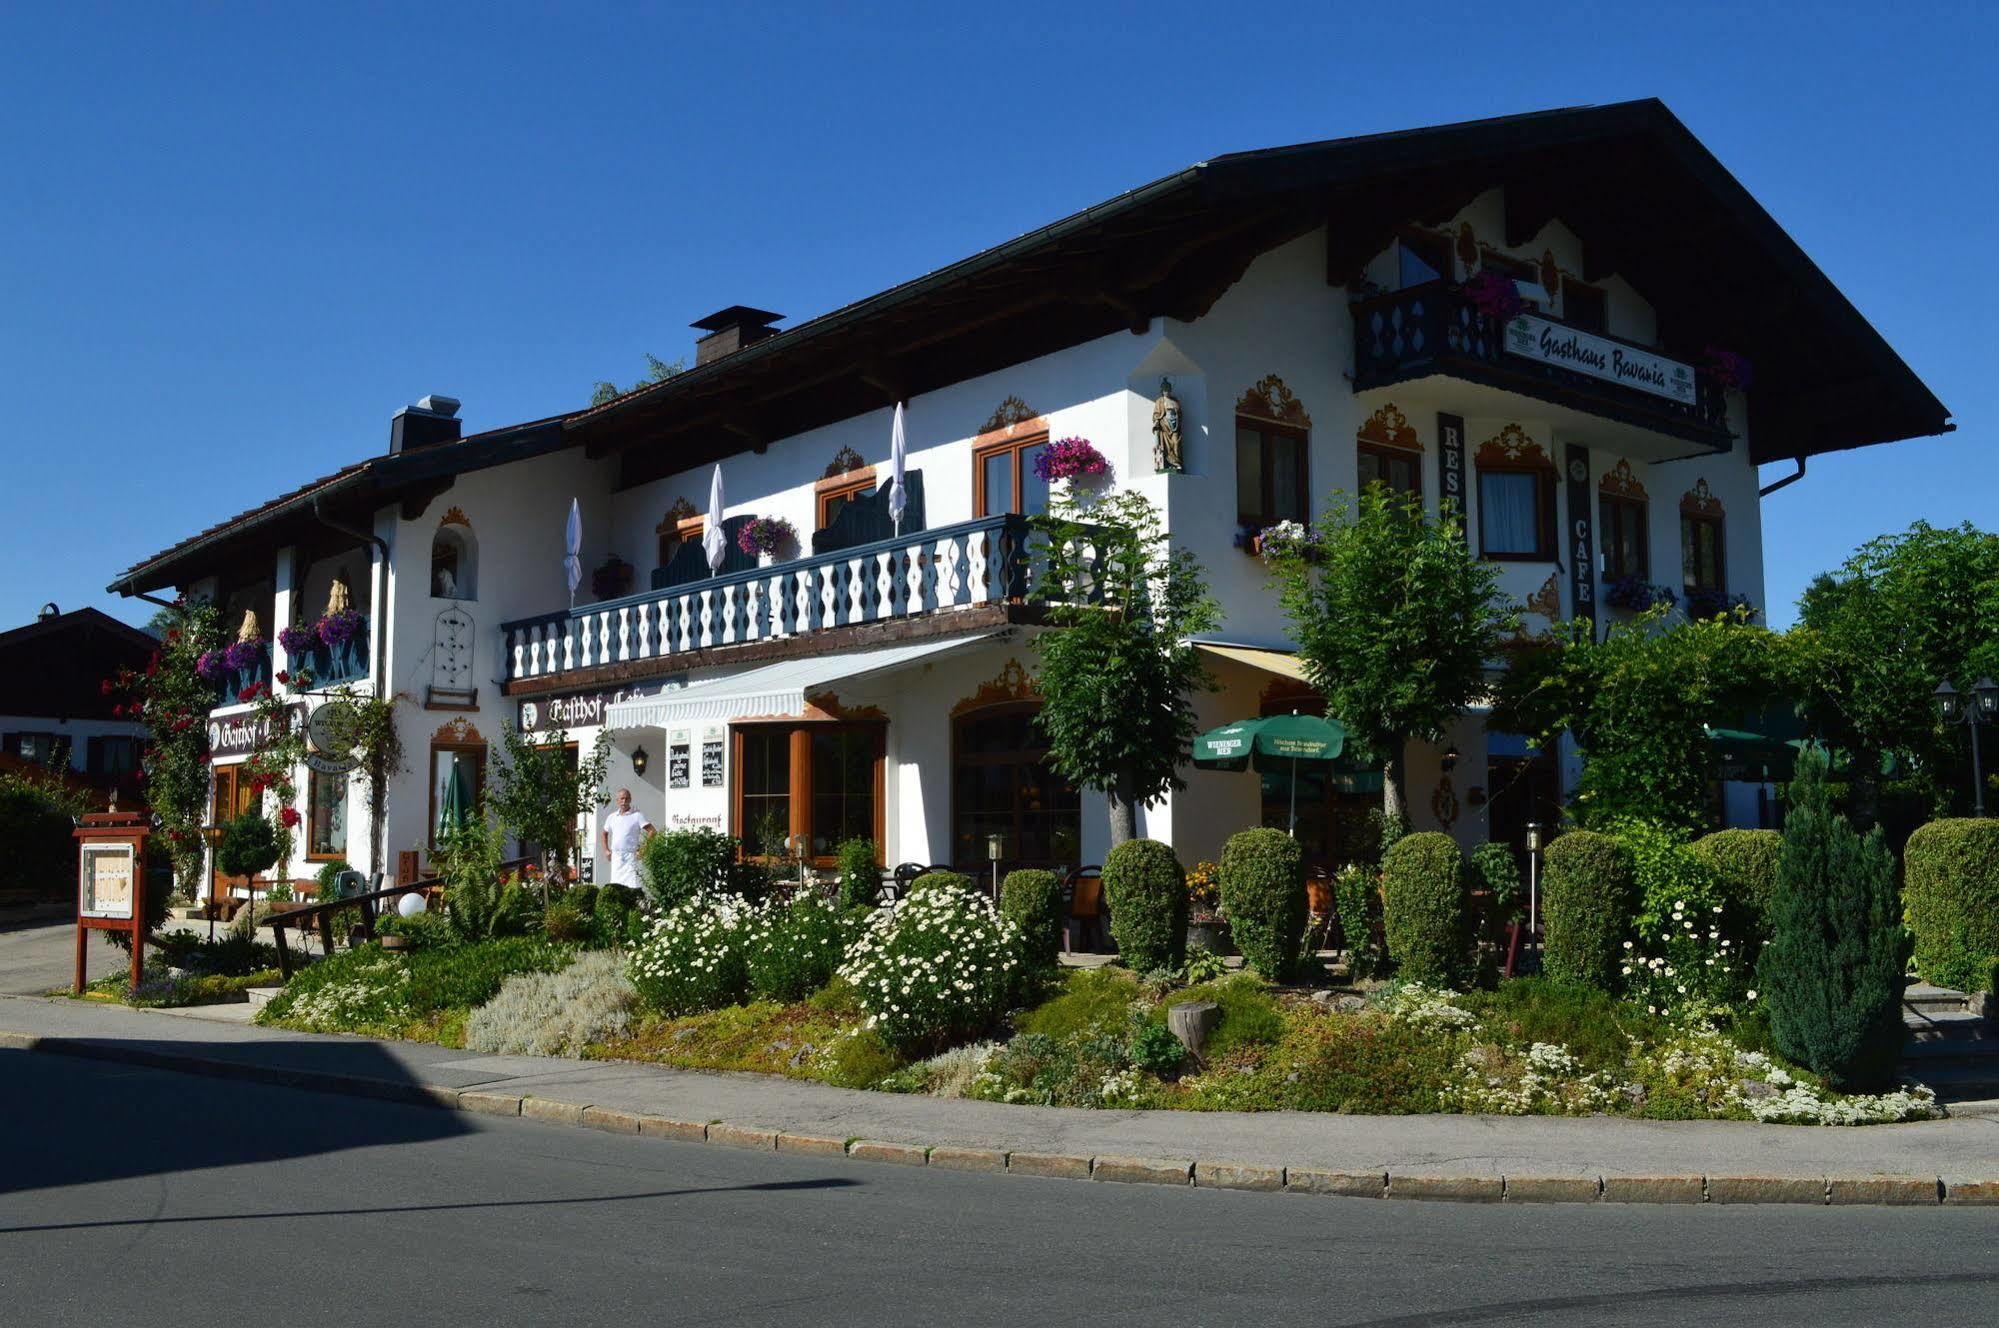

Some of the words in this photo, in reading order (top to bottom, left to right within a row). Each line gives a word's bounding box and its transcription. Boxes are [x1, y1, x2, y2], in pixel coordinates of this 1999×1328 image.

[1540, 327, 1605, 370] Gasthaus
[1612, 349, 1665, 387] Bavaria
[1575, 519, 1591, 601] CAFE
